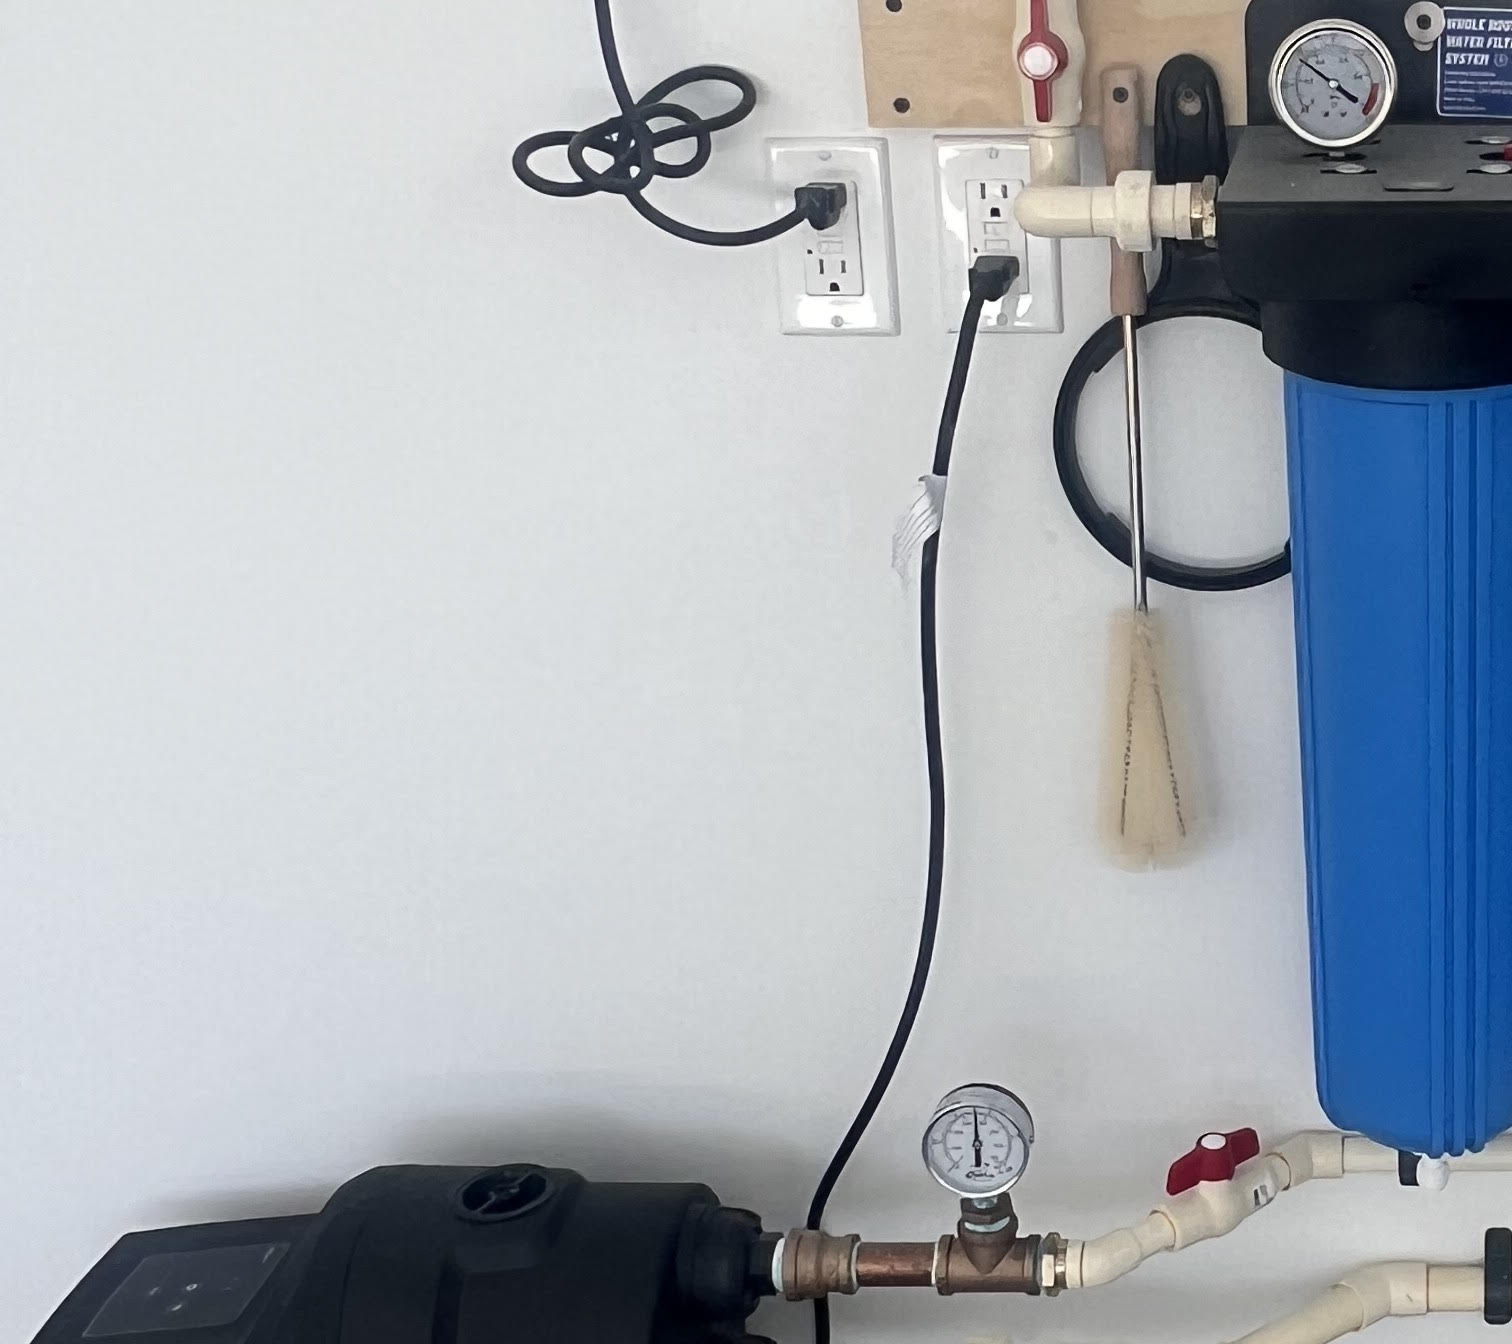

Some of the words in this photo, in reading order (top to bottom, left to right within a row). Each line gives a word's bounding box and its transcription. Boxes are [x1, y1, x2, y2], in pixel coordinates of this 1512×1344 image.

[1446, 18, 1487, 31] WHOLE
[1446, 35, 1485, 49] WATER
[1445, 52, 1490, 66] SYSTEM
